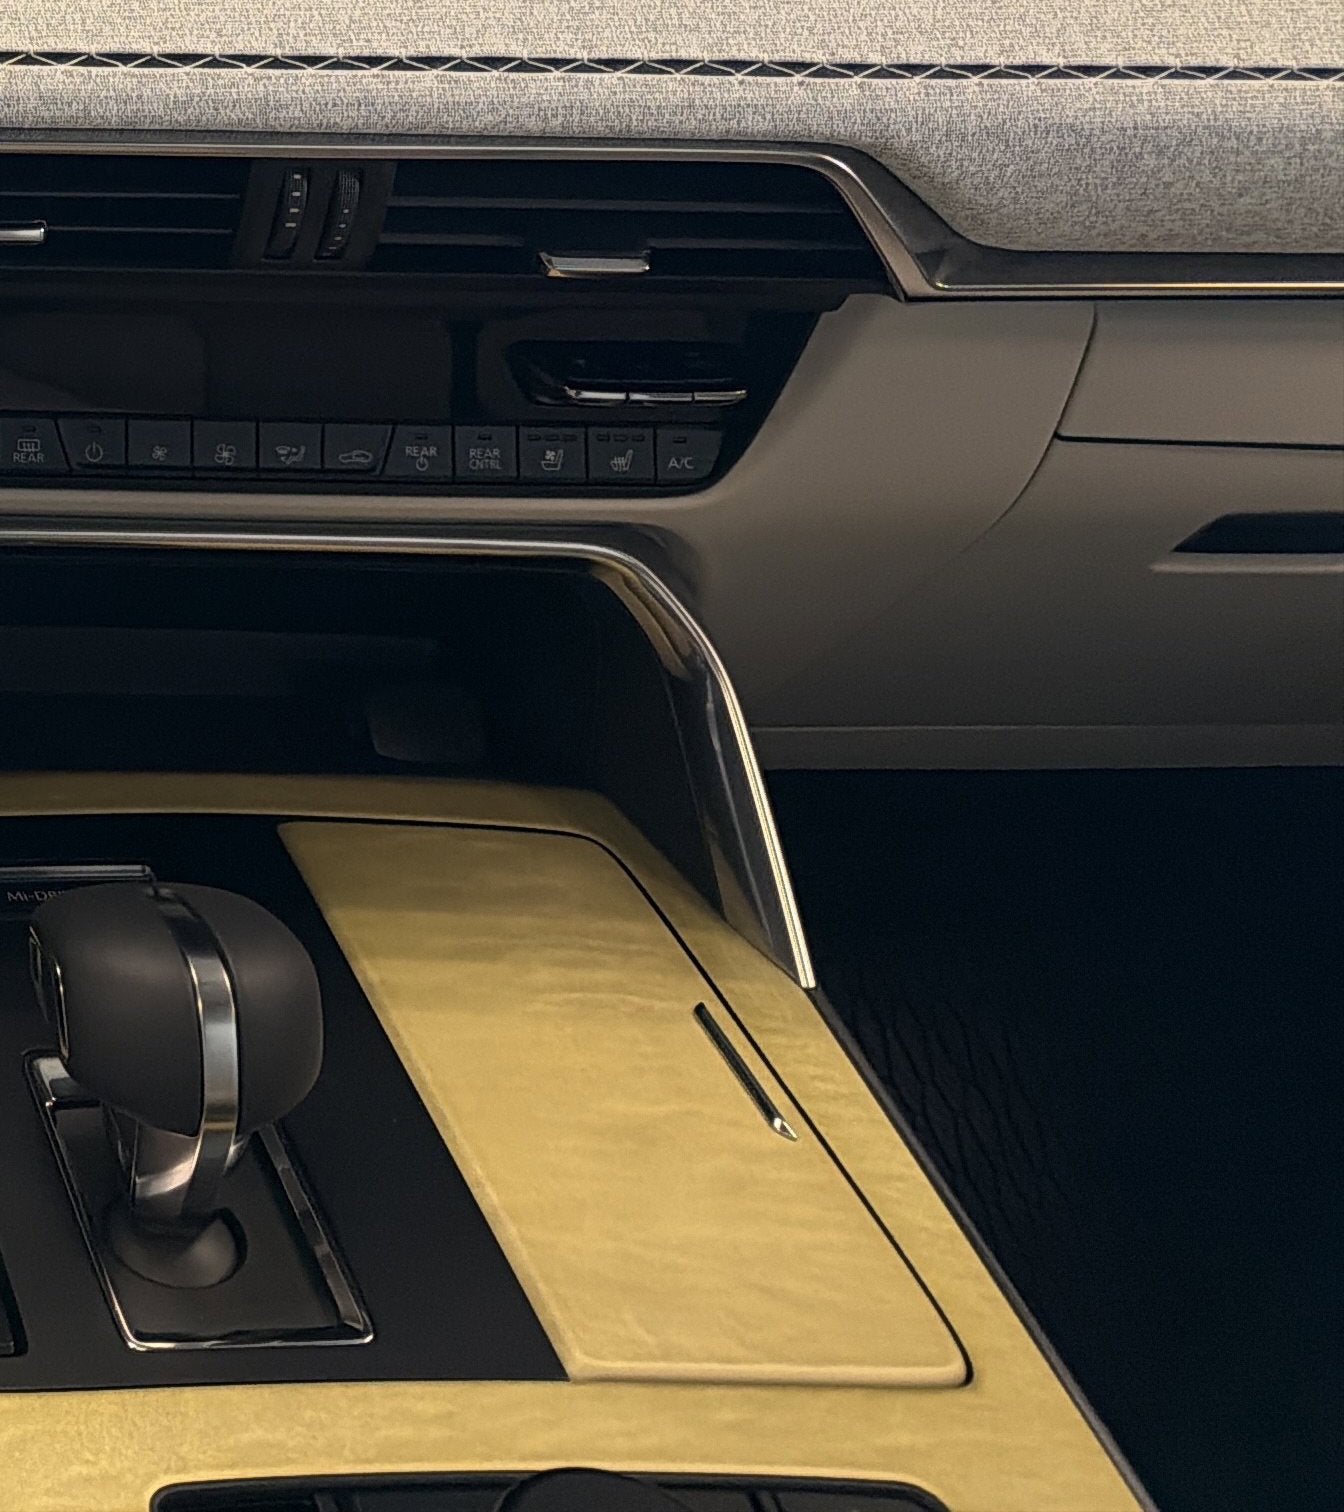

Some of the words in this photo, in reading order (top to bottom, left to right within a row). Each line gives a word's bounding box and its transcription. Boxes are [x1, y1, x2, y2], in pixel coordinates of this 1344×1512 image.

[405, 445, 439, 457] REAR
[469, 447, 502, 459] REAR
[12, 452, 45, 464] REAR
[666, 456, 695, 471] A/C
